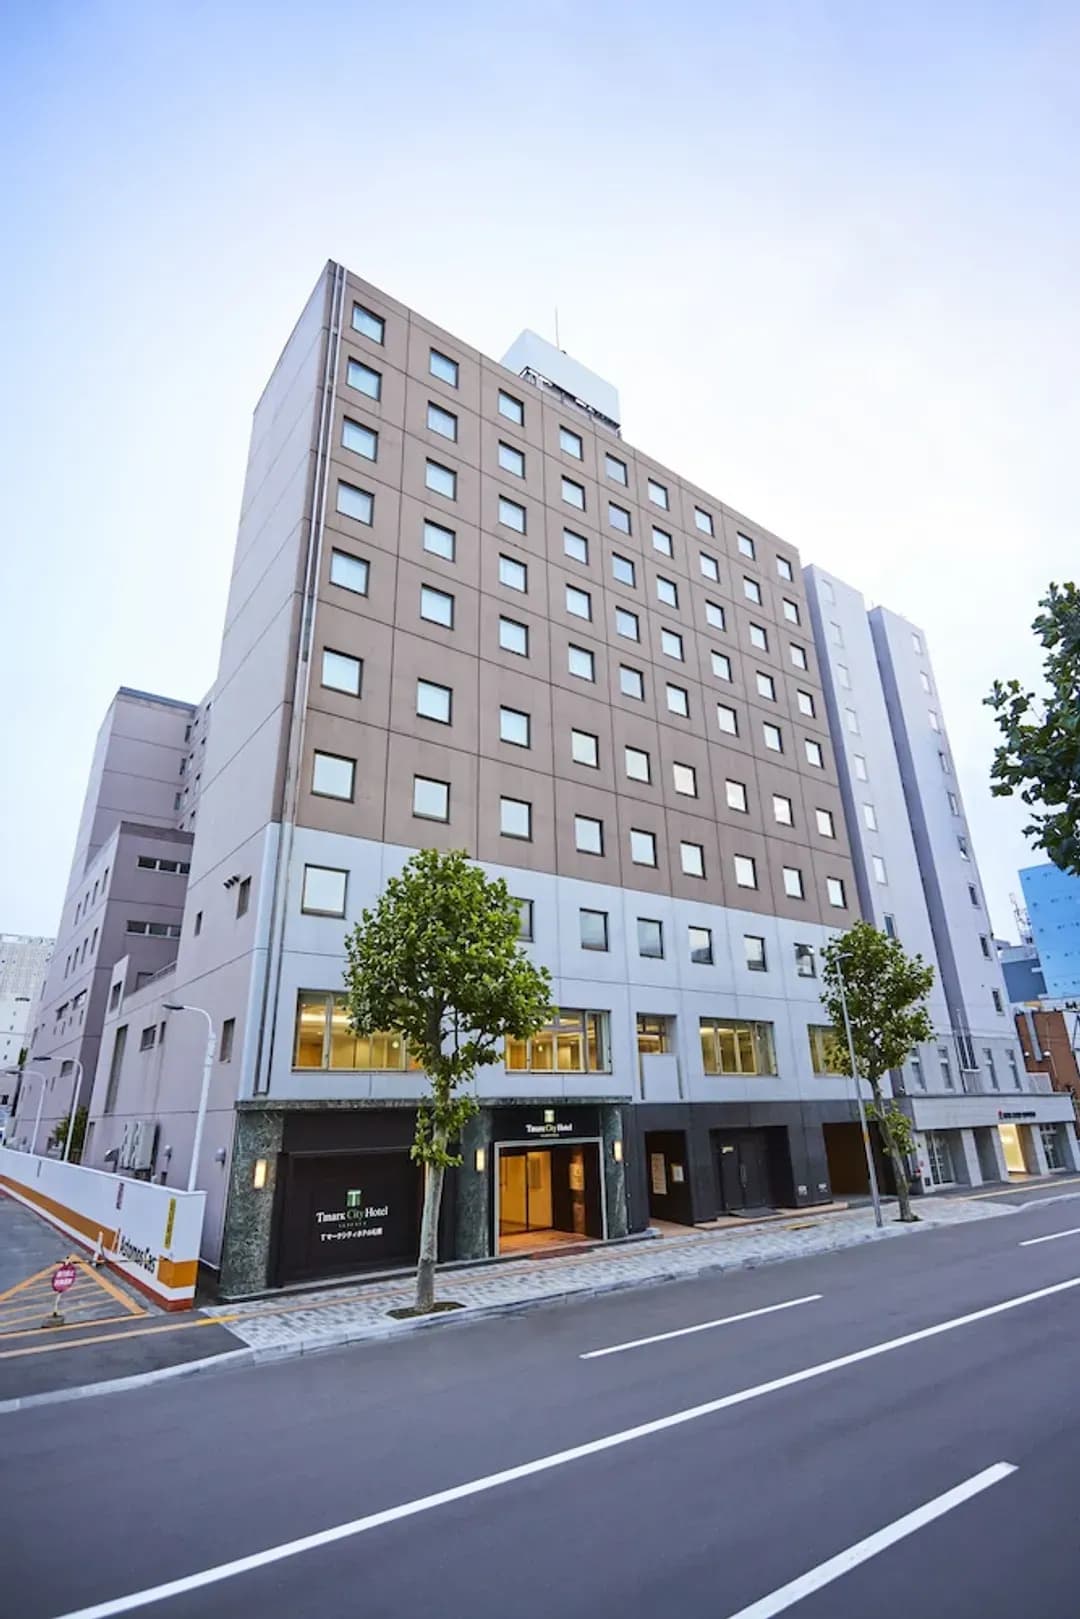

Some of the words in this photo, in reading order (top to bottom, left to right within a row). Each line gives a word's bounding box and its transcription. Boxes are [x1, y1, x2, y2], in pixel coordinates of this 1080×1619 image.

[316, 1212, 346, 1223] Tmark
[346, 1208, 363, 1221] City
[365, 1206, 388, 1218] Hotel
